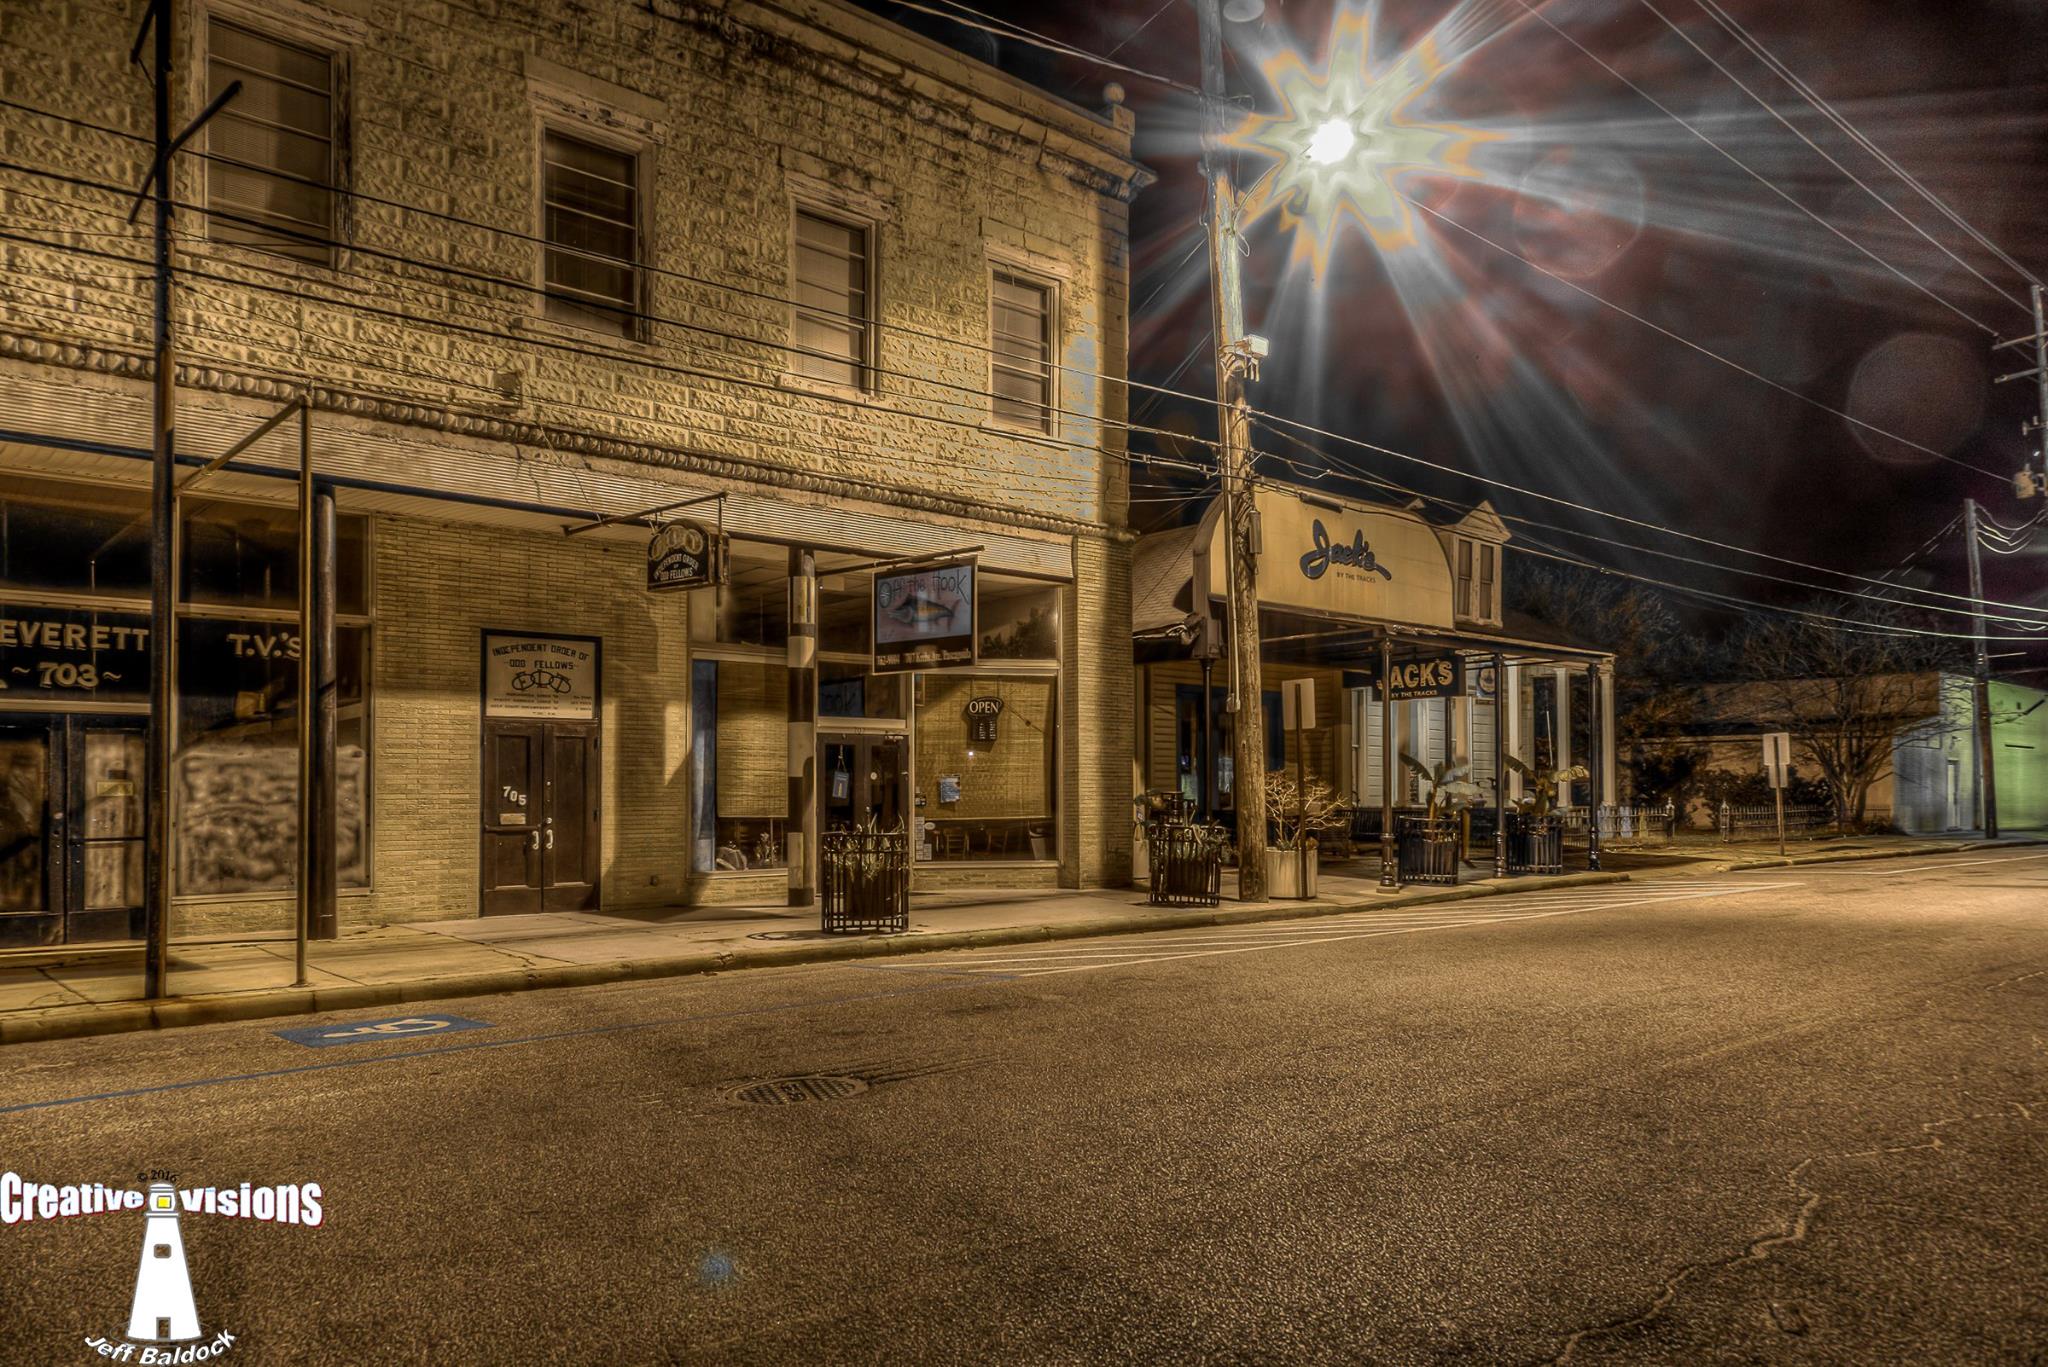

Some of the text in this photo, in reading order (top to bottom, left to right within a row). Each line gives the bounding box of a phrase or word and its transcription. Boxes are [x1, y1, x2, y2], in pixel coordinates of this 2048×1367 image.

[1300, 519, 1392, 580] Jack's
[1356, 575, 1376, 583] TRACKS
[0, 619, 149, 651] EVERETT
[492, 643, 590, 661] INDEPENDENT ORDER OF
[534, 660, 574, 670] FELLOWS
[37, 661, 99, 689] 703
[969, 701, 1000, 714] OPEN
[503, 785, 527, 806] 705
